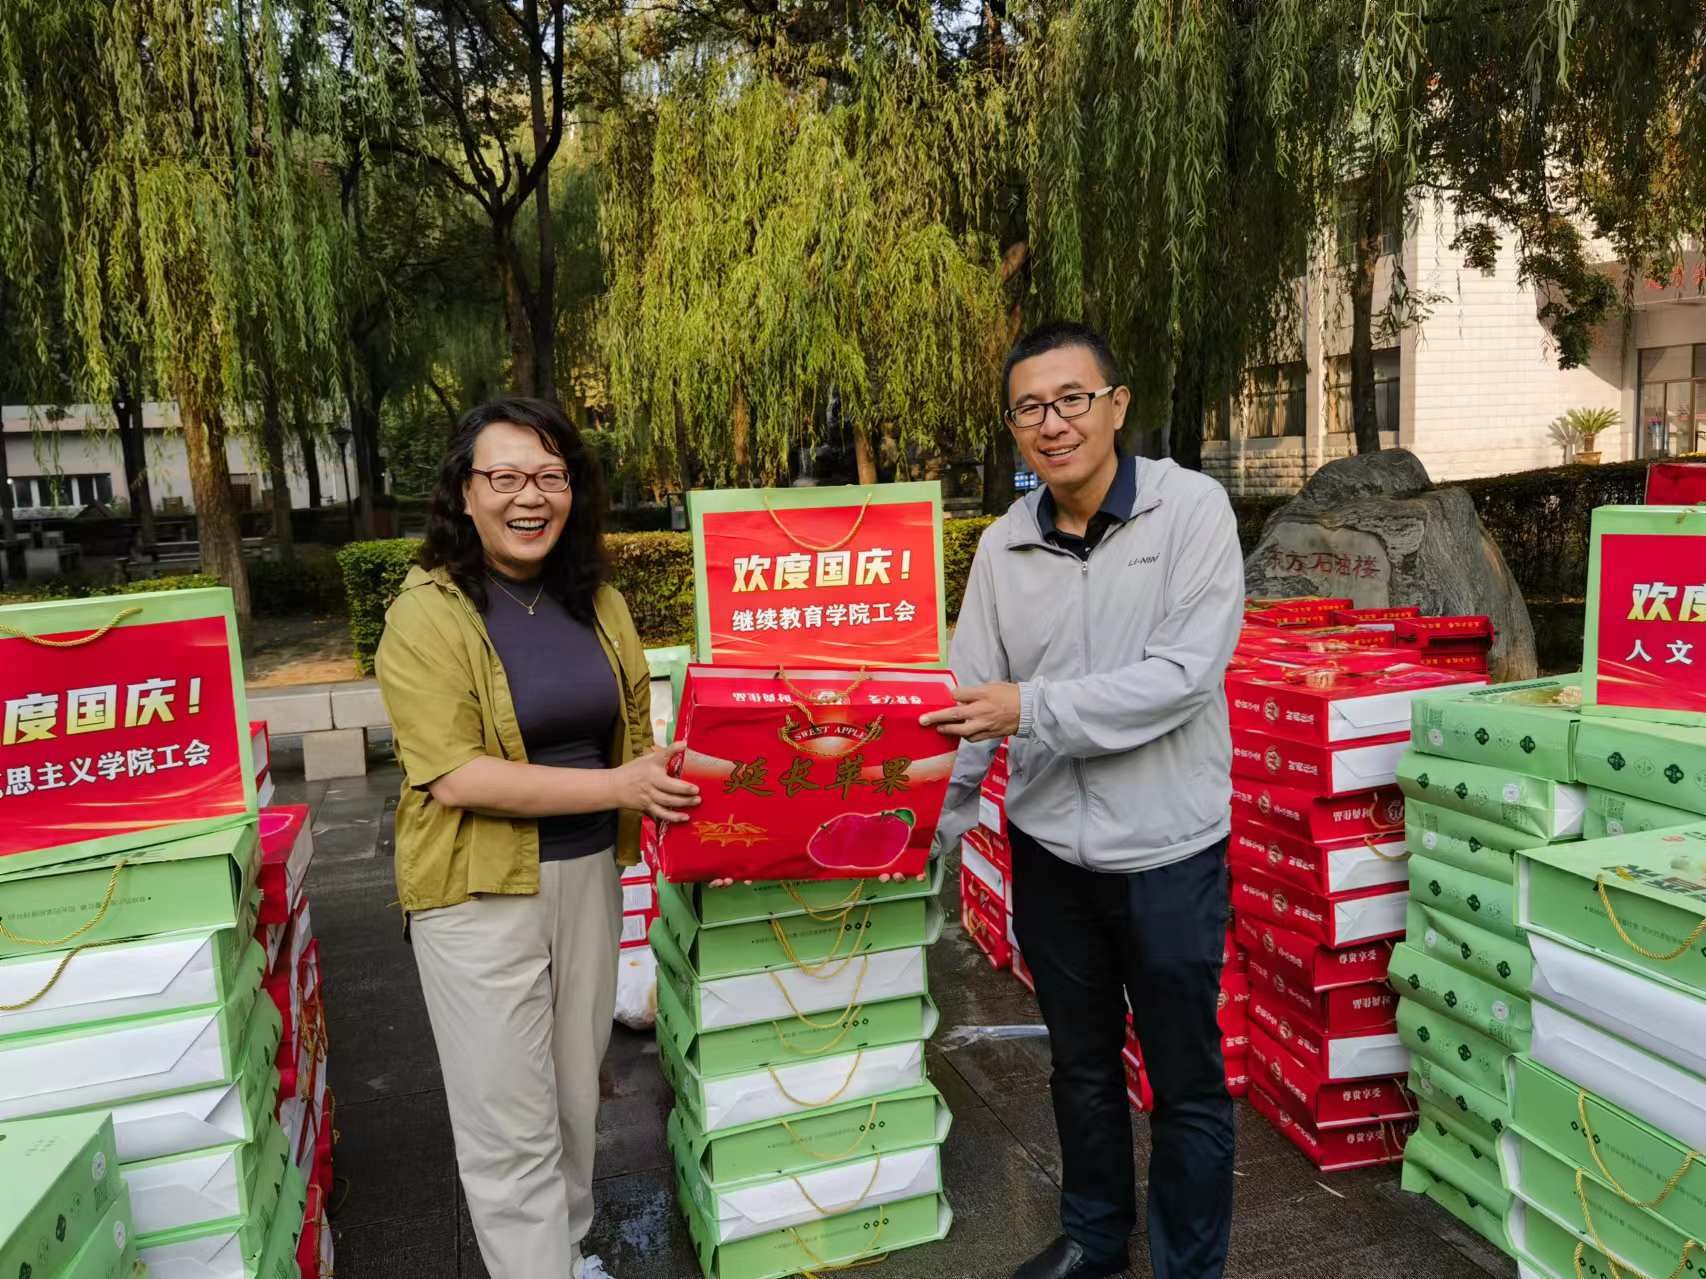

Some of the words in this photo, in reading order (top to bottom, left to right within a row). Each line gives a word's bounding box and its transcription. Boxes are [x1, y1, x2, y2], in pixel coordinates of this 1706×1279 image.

[732, 599, 917, 633] 继续教育学院工会
[834, 725, 867, 740] APPLE
[0, 739, 212, 799] 思主义学院工会
[723, 753, 913, 800] 延长苹果
